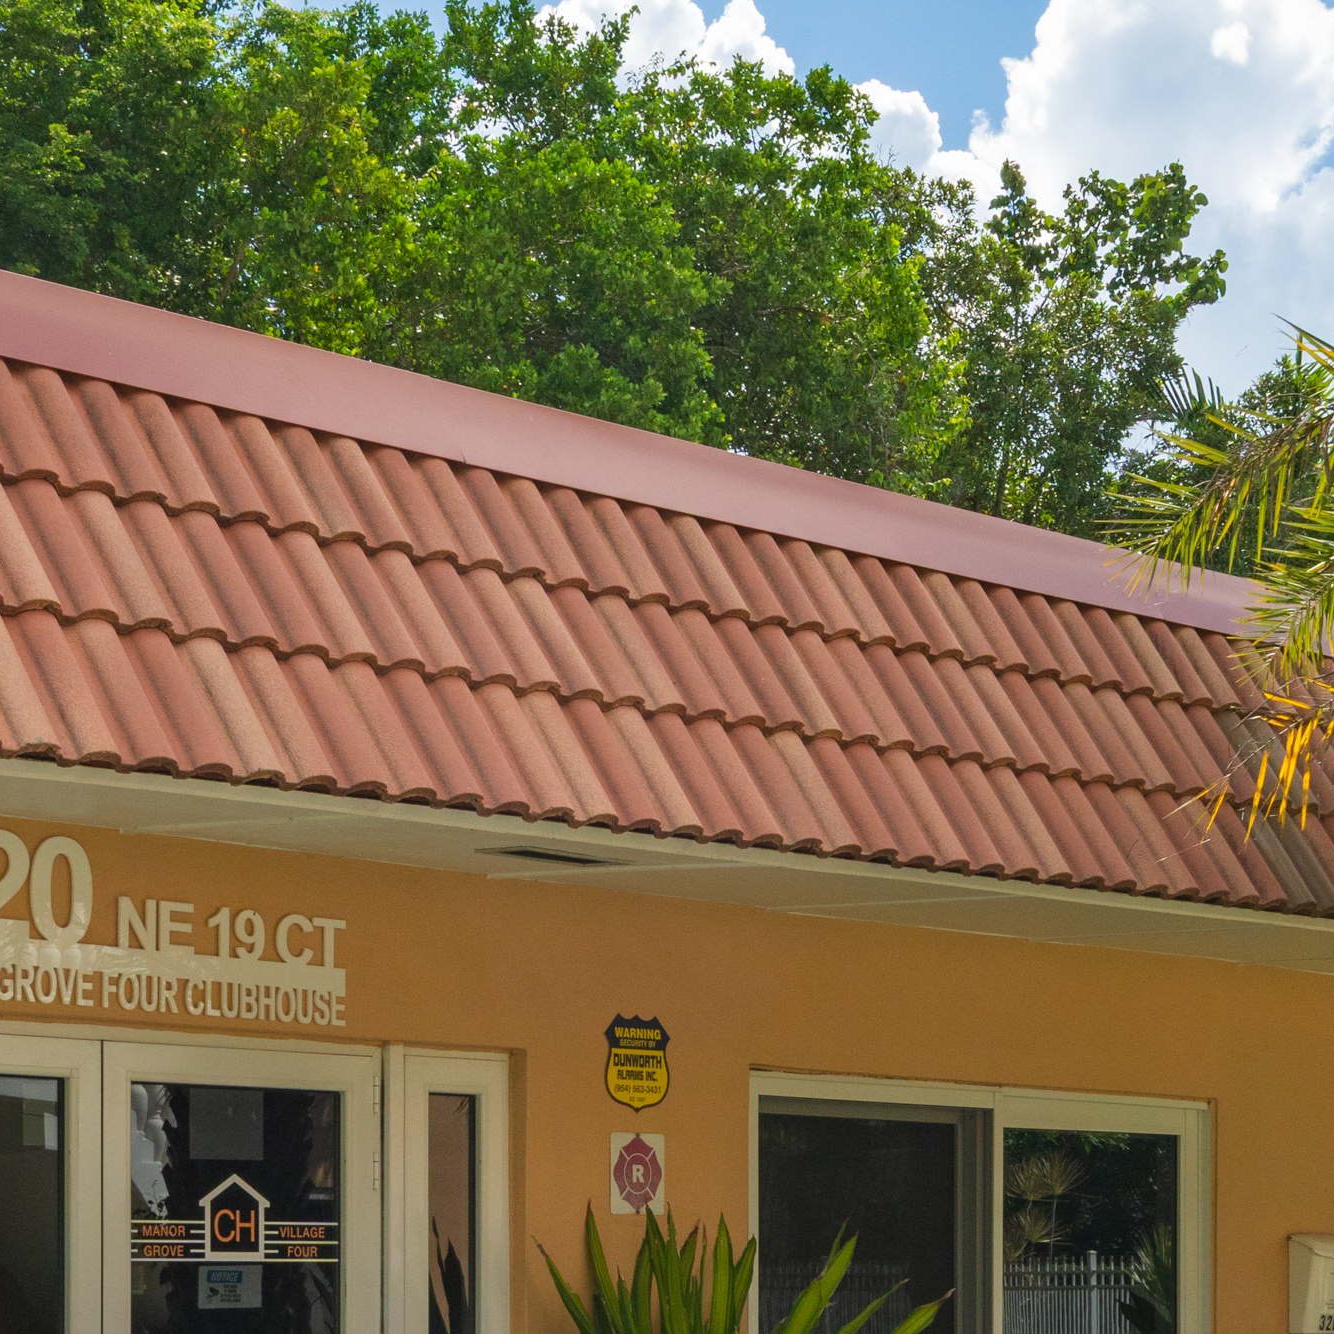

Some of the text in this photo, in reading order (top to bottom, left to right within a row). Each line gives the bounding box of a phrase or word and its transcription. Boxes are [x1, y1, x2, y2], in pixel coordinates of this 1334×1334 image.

[118, 896, 195, 954] NE
[207, 906, 266, 960] 19
[275, 914, 347, 968] CT
[102, 971, 178, 1013] FOUR
[186, 978, 347, 1027] CLUBHOUSE
[614, 1026, 662, 1041] WARNING
[619, 1039, 657, 1048] SECURITY BY
[613, 1053, 662, 1069] DUNWORTH
[617, 1069, 658, 1082] ALARMS INC.
[614, 1084, 662, 1094] (954) 563-3431
[632, 1164, 645, 1184] R
[142, 1225, 325, 1239] MANOR VILLAGE
[213, 1209, 255, 1242] CH
[143, 1245, 317, 1258] GROVE FOUR
[210, 1271, 239, 1282] NOTICE
